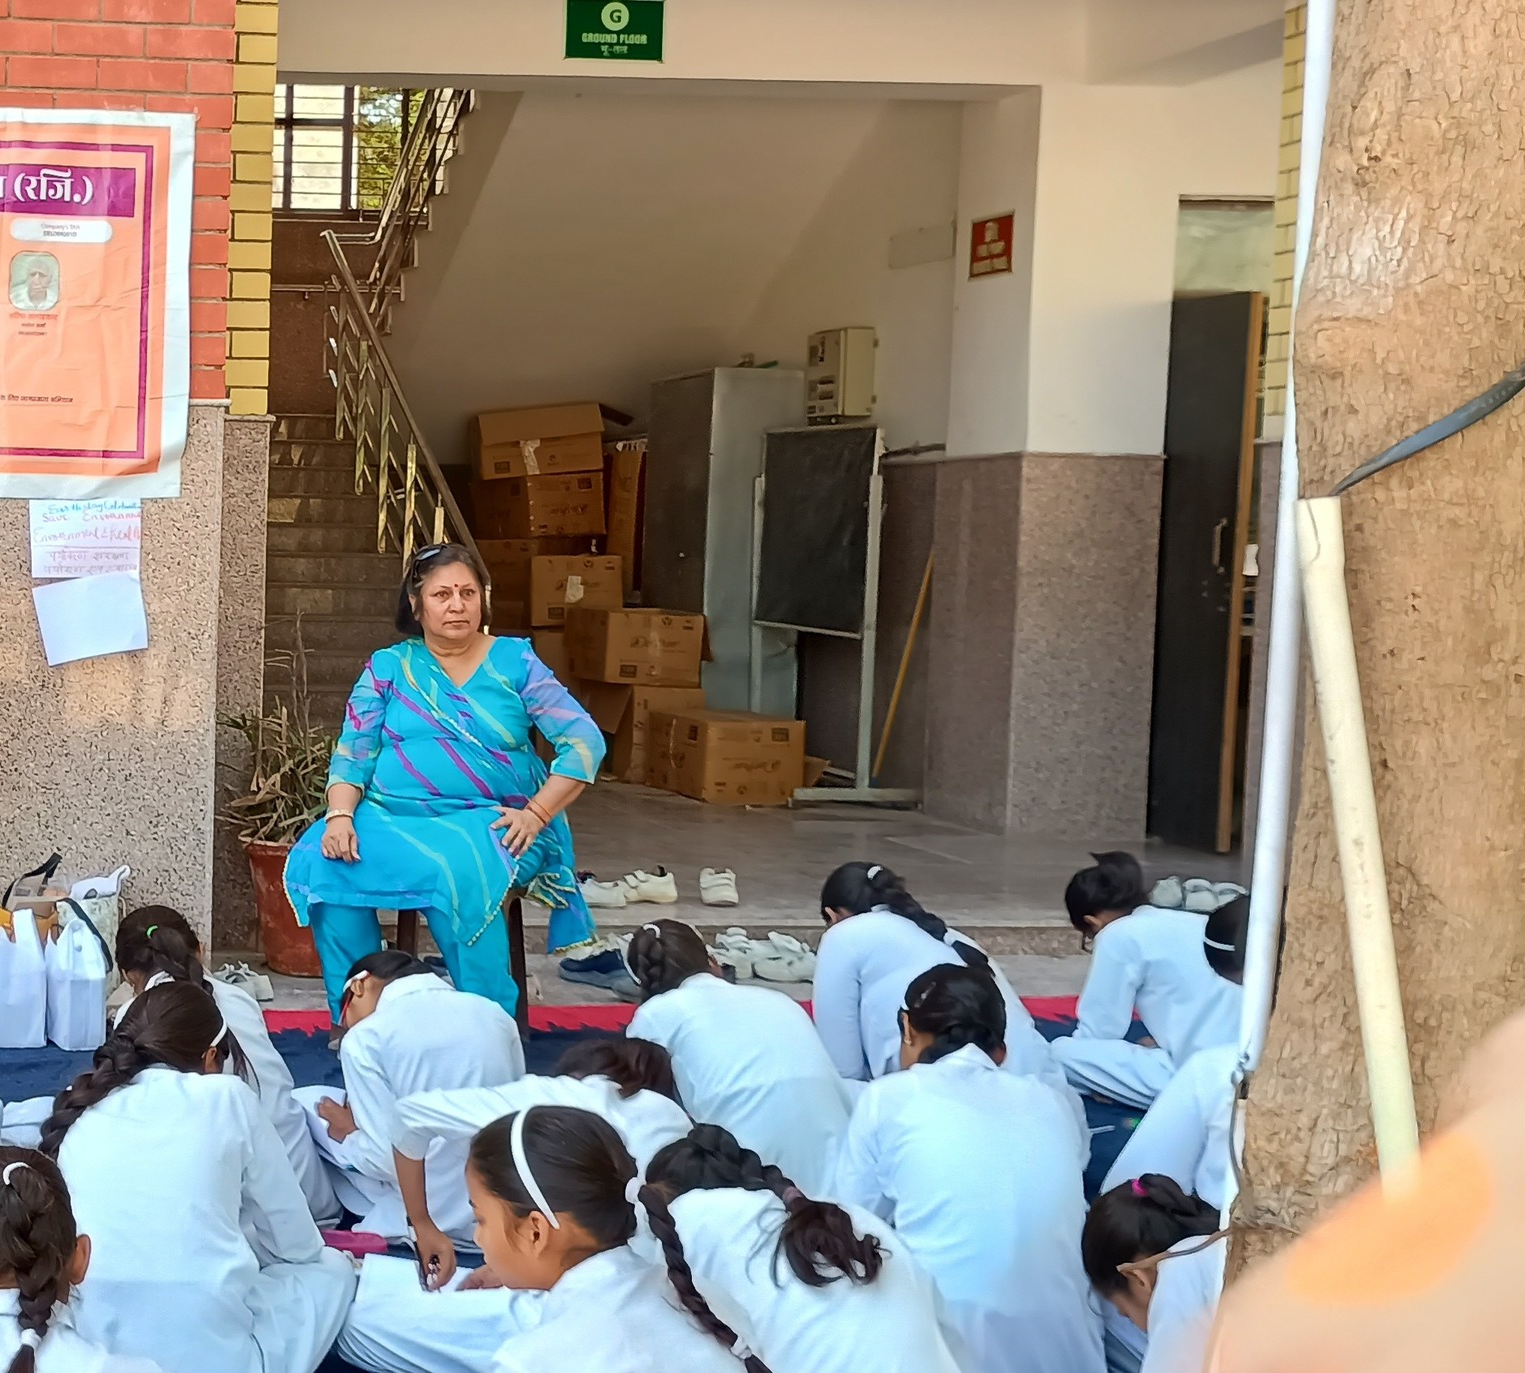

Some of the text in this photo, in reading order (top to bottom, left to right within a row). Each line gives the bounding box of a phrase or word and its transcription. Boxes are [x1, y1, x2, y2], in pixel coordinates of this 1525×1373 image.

[609, 9, 622, 23] G
[581, 32, 648, 45] GROUND FLOOR
[13, 168, 95, 205] (रजि.)
